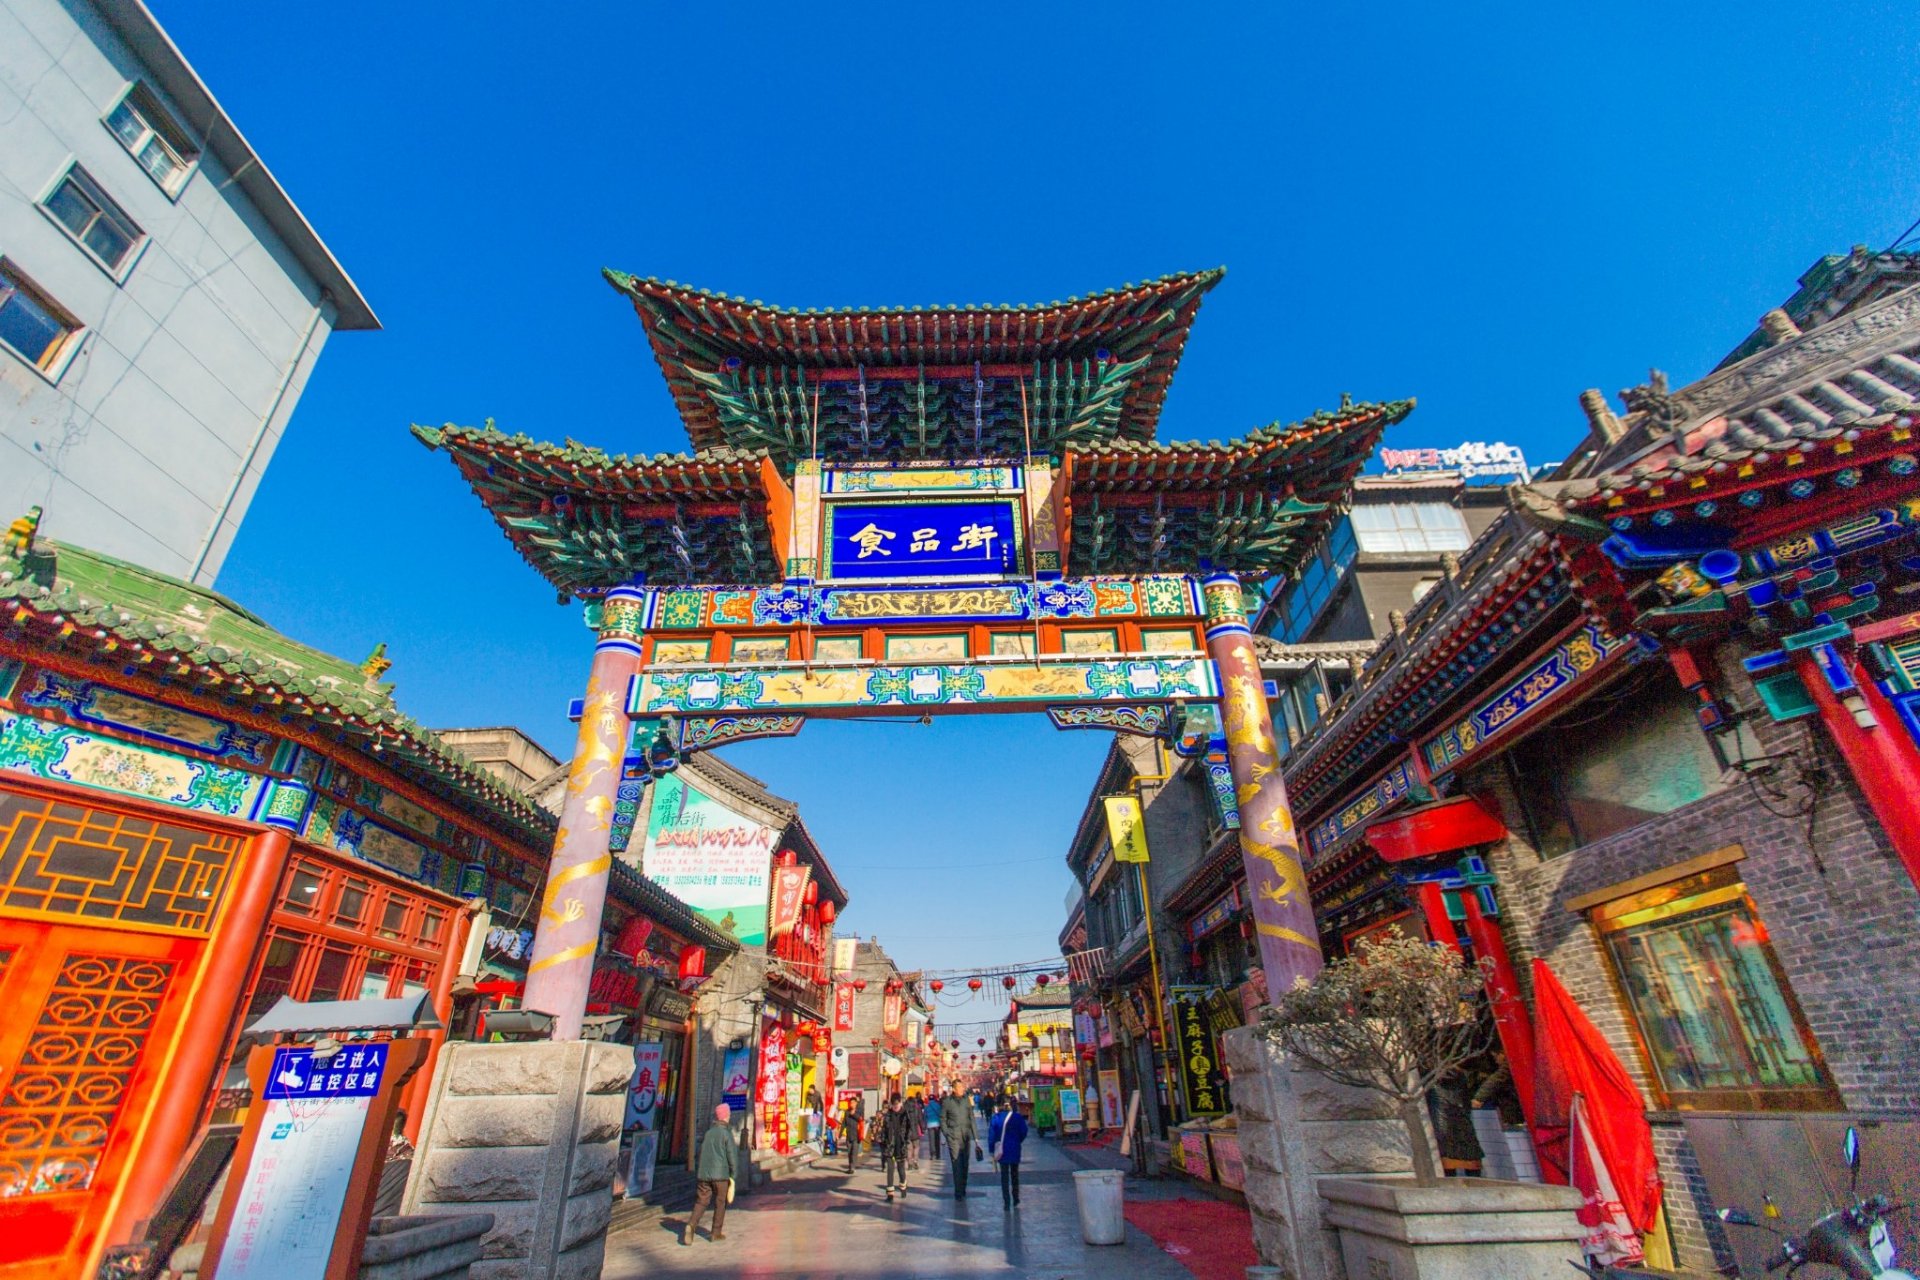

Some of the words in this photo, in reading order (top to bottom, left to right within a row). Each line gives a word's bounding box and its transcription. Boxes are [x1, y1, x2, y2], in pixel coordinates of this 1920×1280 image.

[849, 522, 998, 560] 食品街
[1185, 1006, 1215, 1111] 王麻子臭豆腐
[308, 1072, 378, 1091] 监控区域
